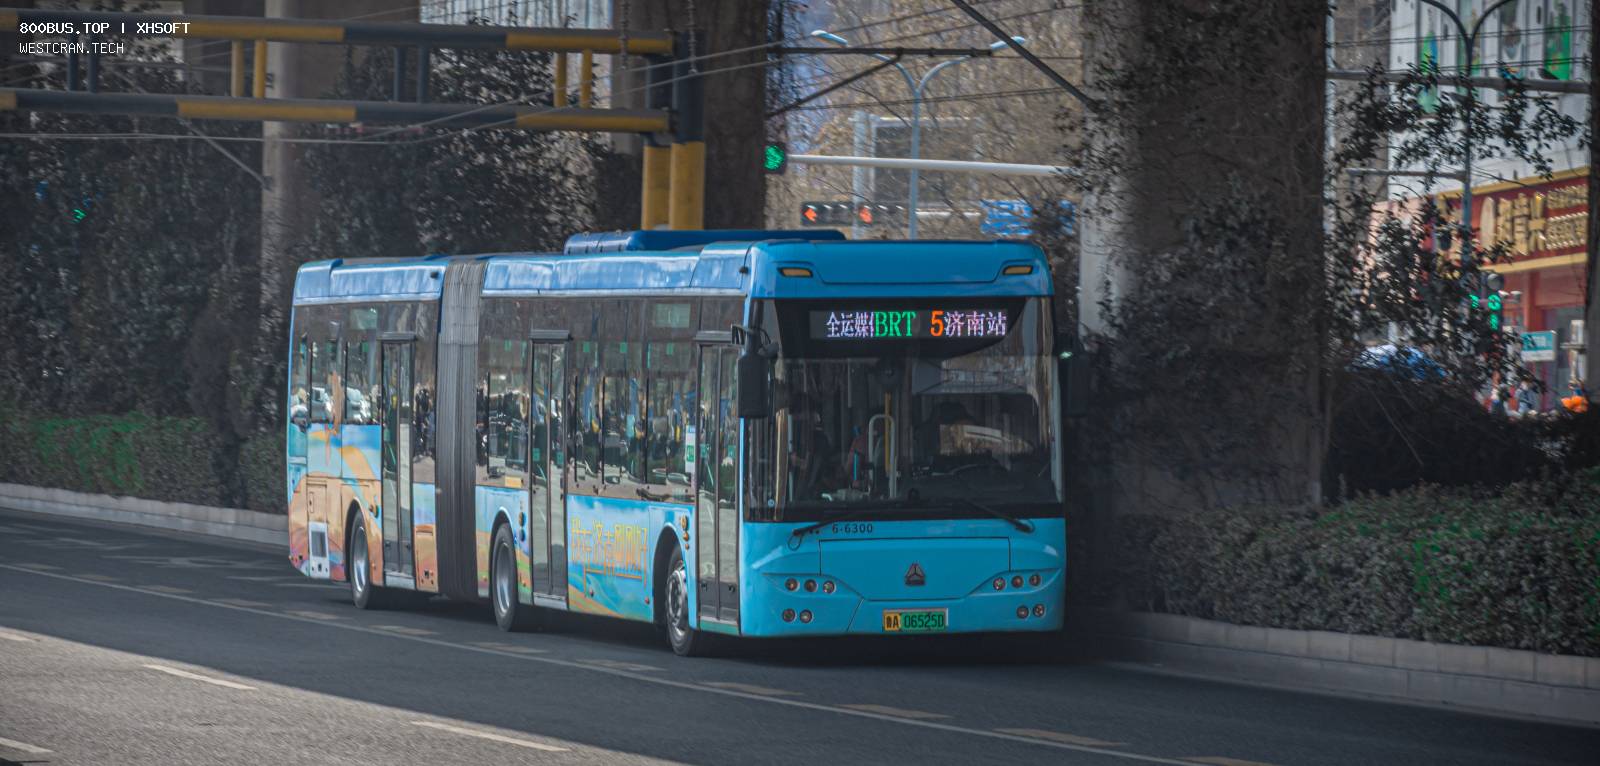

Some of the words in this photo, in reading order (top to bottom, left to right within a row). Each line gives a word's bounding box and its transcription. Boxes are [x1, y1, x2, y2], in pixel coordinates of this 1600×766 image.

[874, 311, 916, 338] BRT
[930, 310, 944, 337] 5
[944, 310, 1007, 337] 济南站
[832, 523, 873, 534] 6-6300
